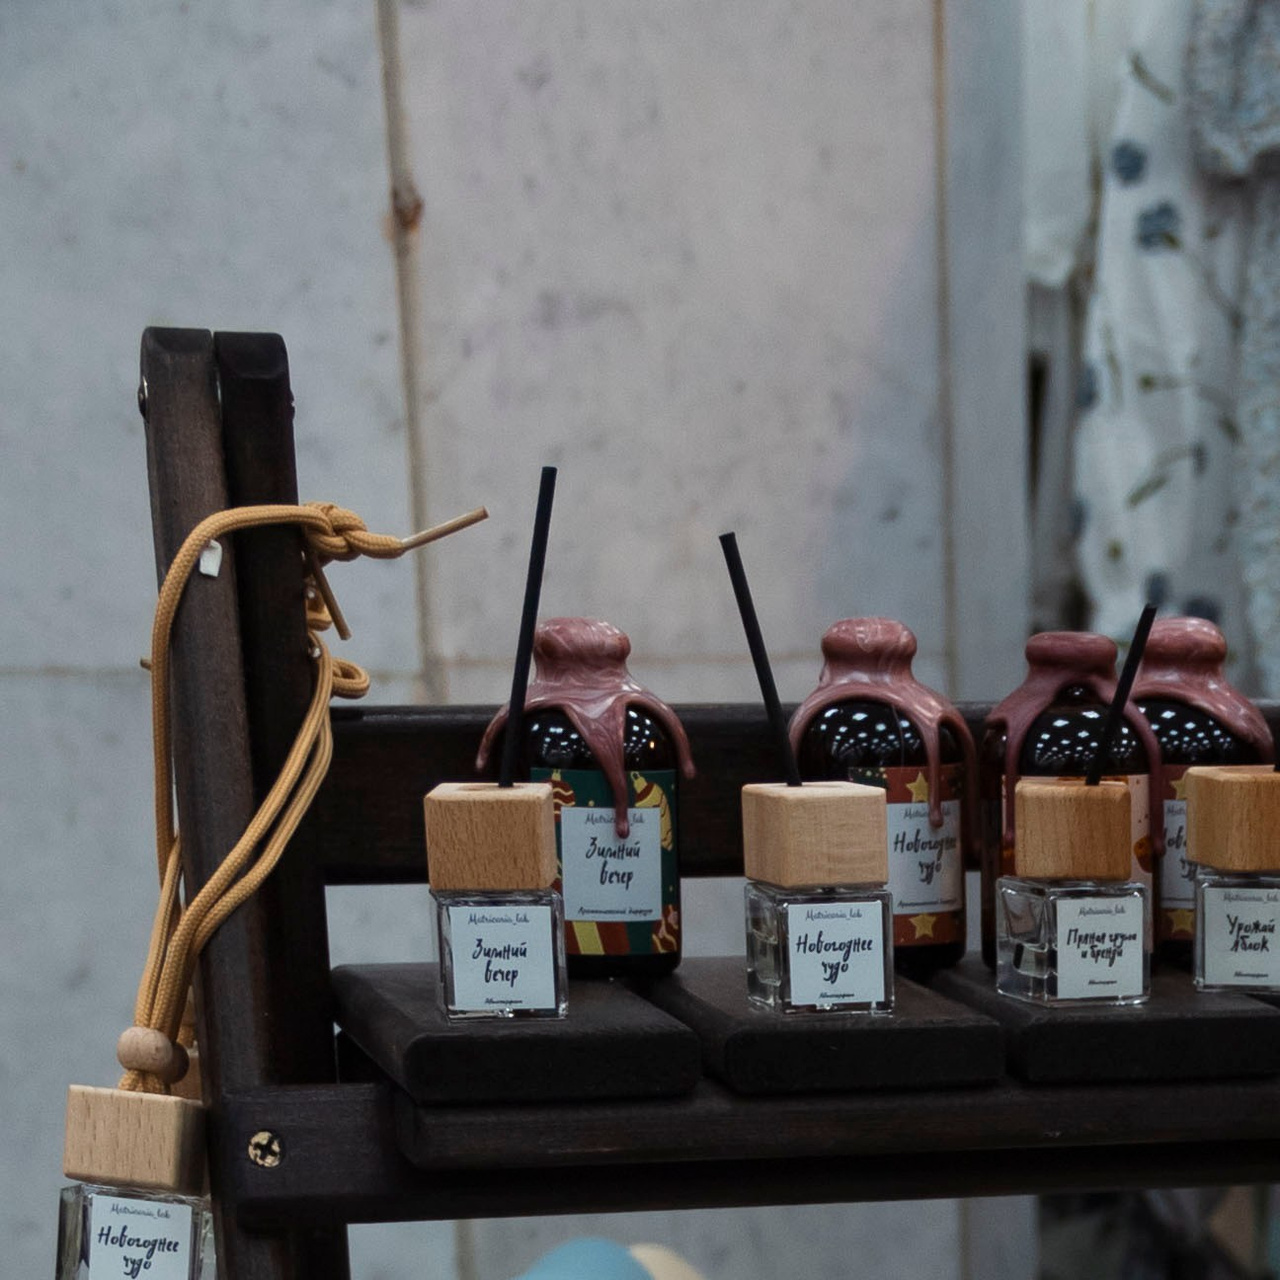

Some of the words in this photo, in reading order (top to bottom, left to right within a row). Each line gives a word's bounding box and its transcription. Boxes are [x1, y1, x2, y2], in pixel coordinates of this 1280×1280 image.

[585, 836, 641, 860] Зимний
[600, 860, 634, 890] вечер
[1226, 914, 1276, 937] Урожай
[472, 938, 528, 960] Зимний
[796, 930, 873, 962] Новогоднее
[1230, 935, 1271, 953] яблок
[484, 960, 519, 988] вечер
[821, 960, 850, 984] чудо
[97, 1225, 180, 1261] Новогоднее
[122, 1254, 153, 1280] чудо
